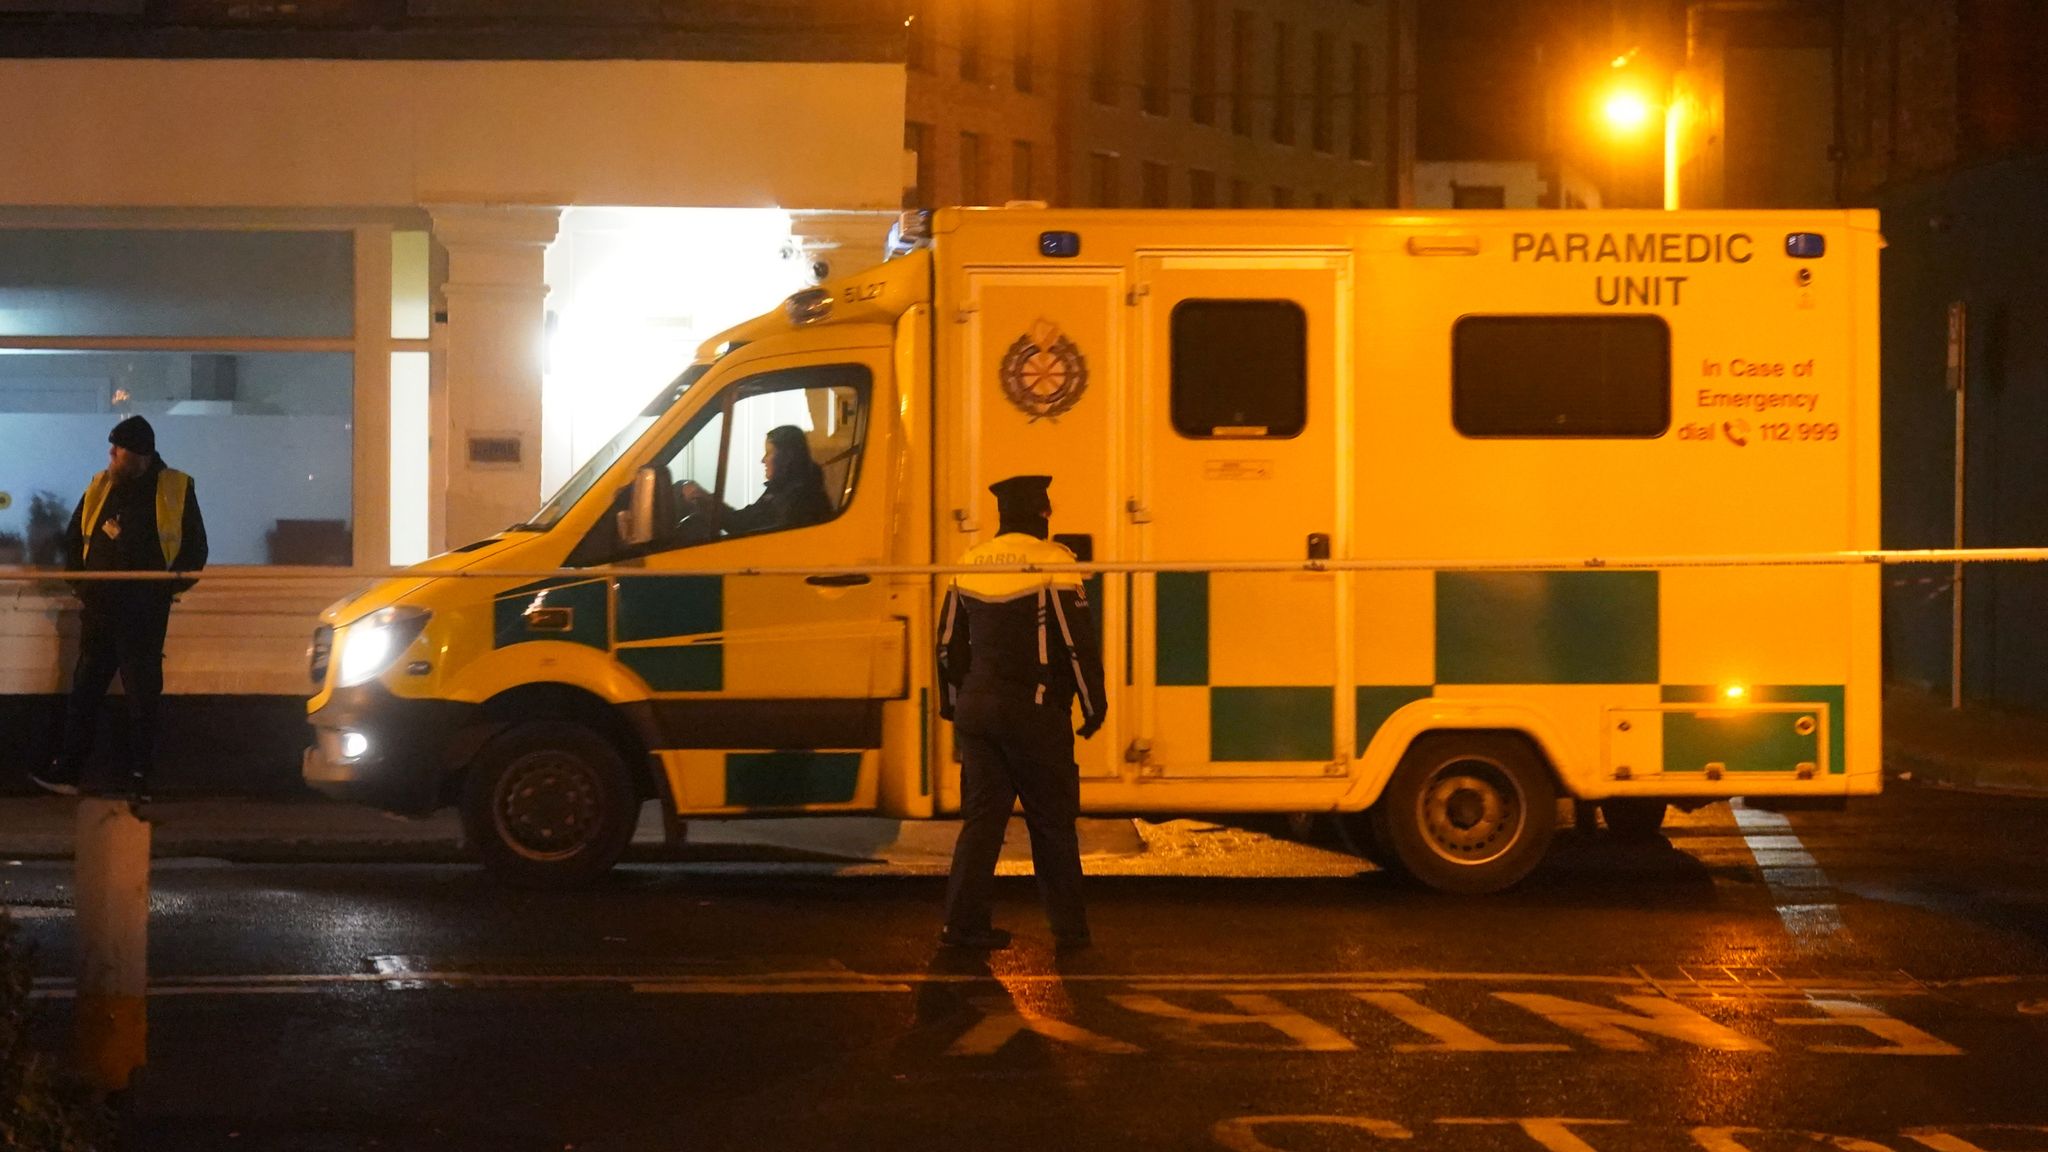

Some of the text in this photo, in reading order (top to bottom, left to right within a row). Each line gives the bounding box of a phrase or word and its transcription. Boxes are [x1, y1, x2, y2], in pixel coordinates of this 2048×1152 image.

[1511, 232, 1754, 264] PARAMEDIC
[1595, 275, 1689, 306] UNIT
[1702, 358, 1814, 377] In Case of
[1697, 388, 1820, 413] Emergency
[1677, 422, 1716, 441] dial
[974, 552, 1027, 567] GARDA
